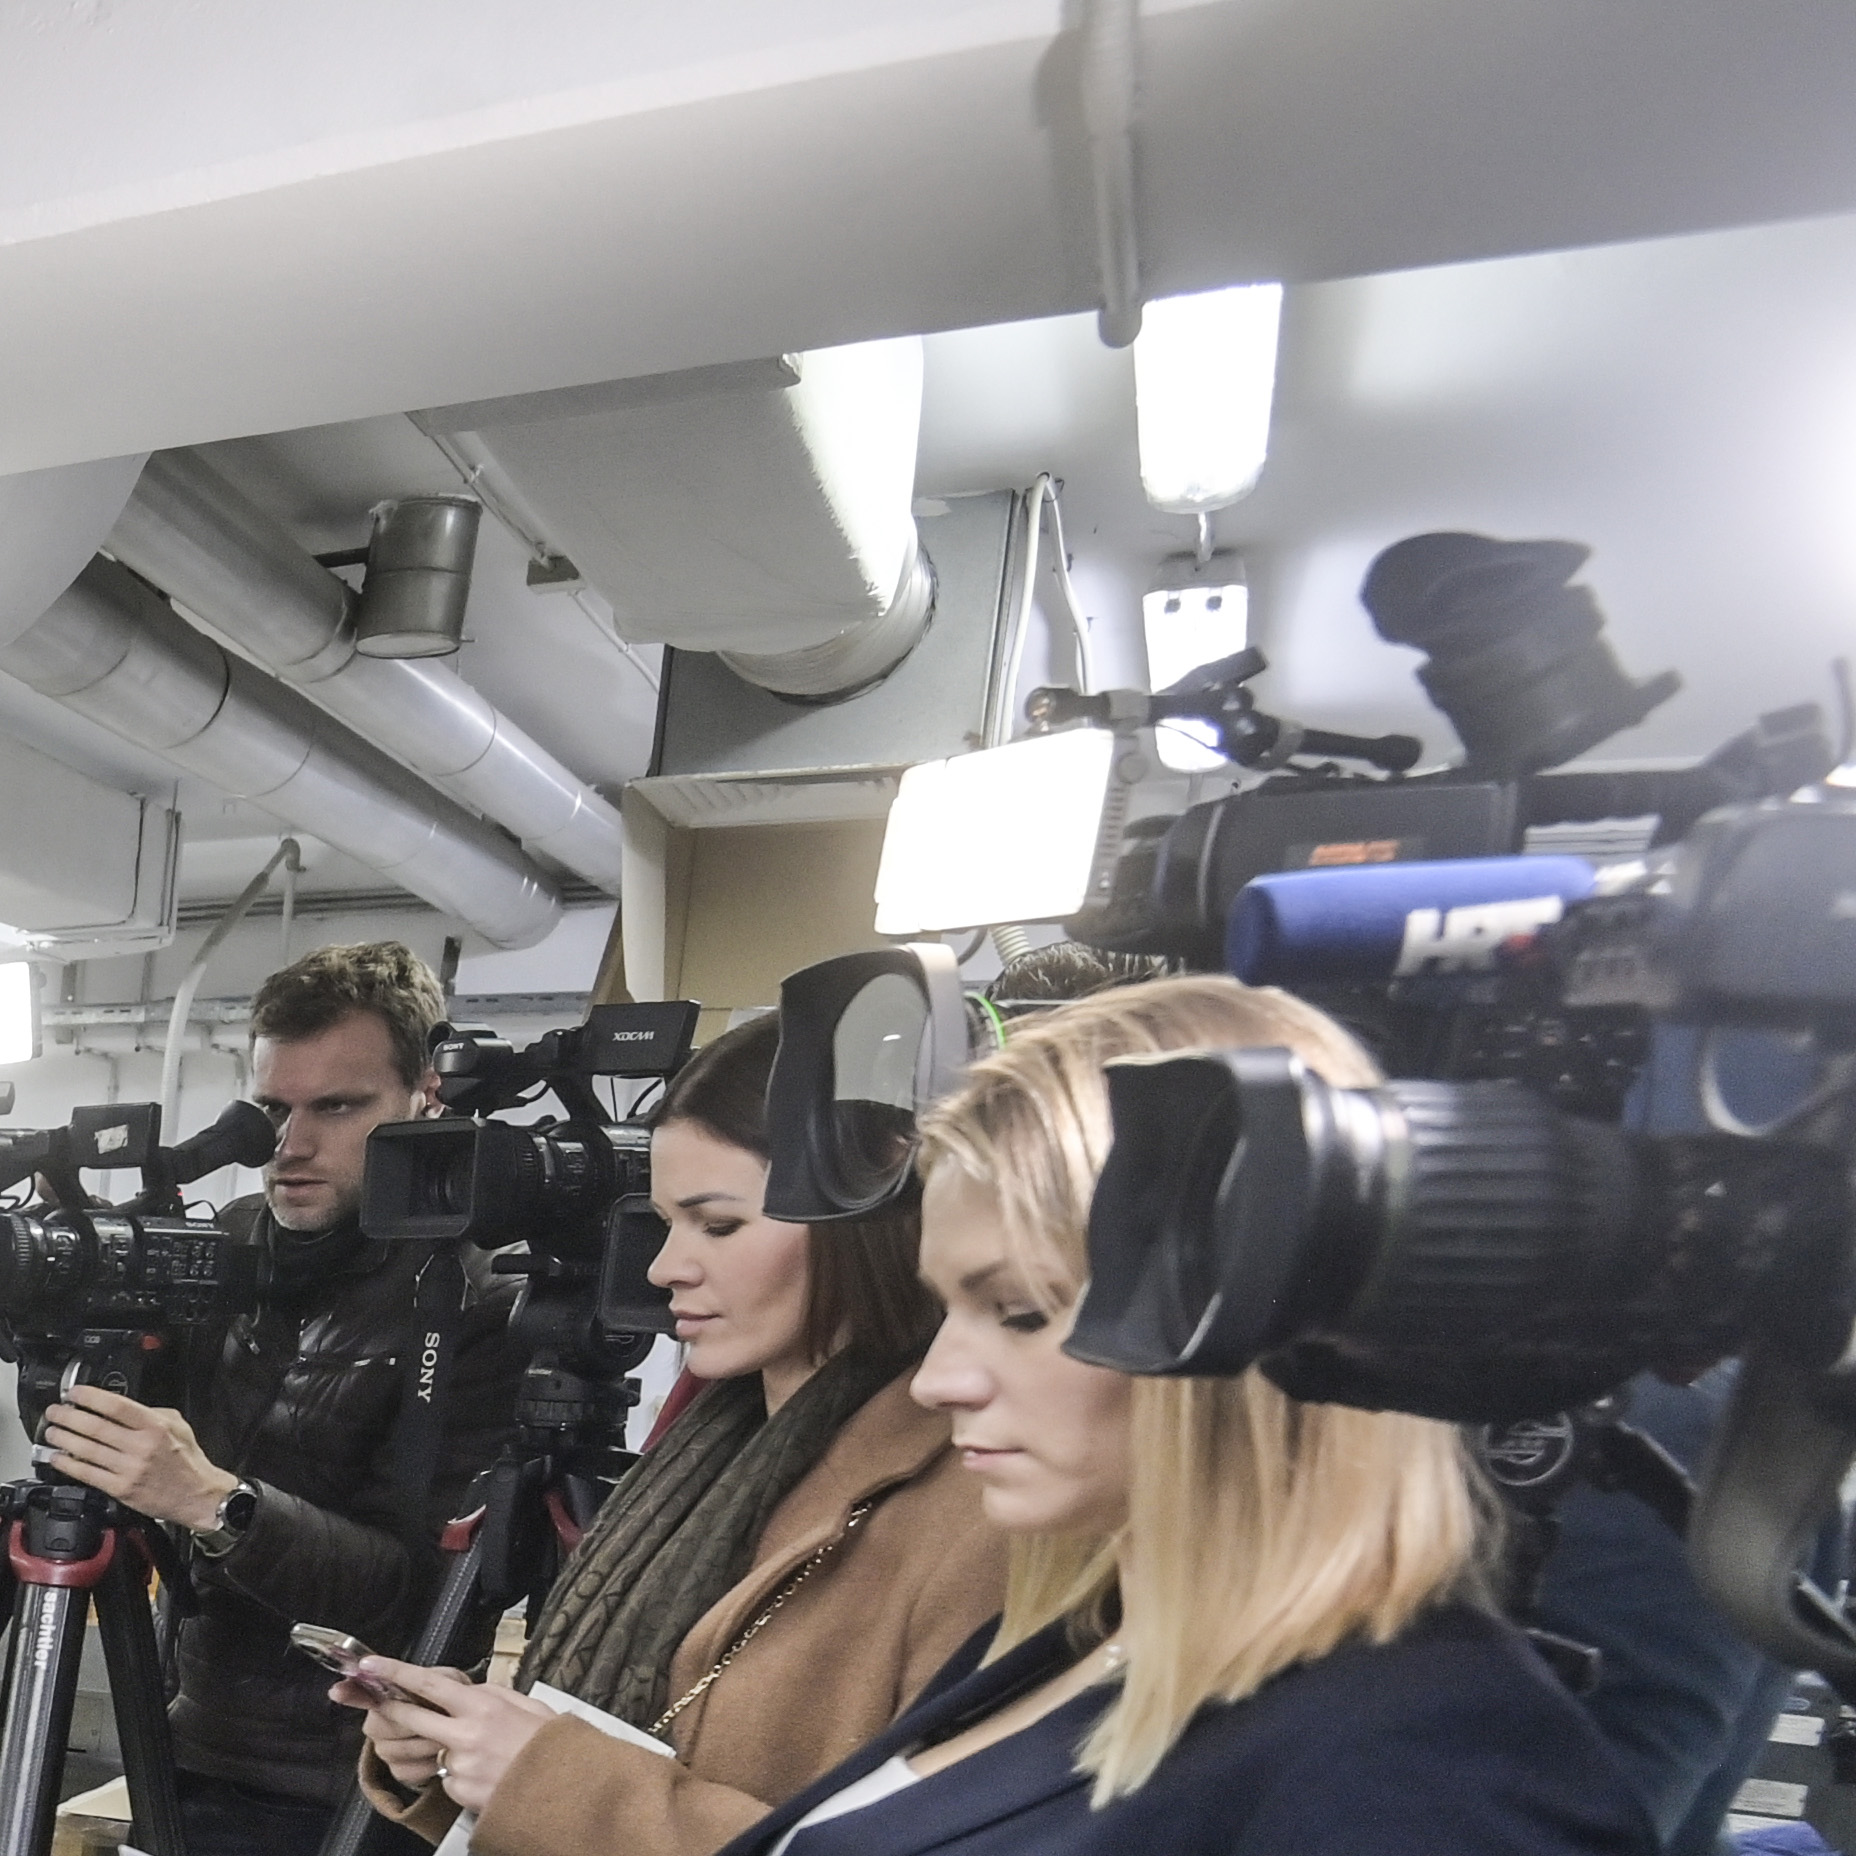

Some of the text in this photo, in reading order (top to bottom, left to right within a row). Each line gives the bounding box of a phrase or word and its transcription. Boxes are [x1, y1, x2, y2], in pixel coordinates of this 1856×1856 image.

[442, 1042, 464, 1051] SONY
[417, 1332, 440, 1403] SONY
[34, 1591, 58, 1670] sachtler
